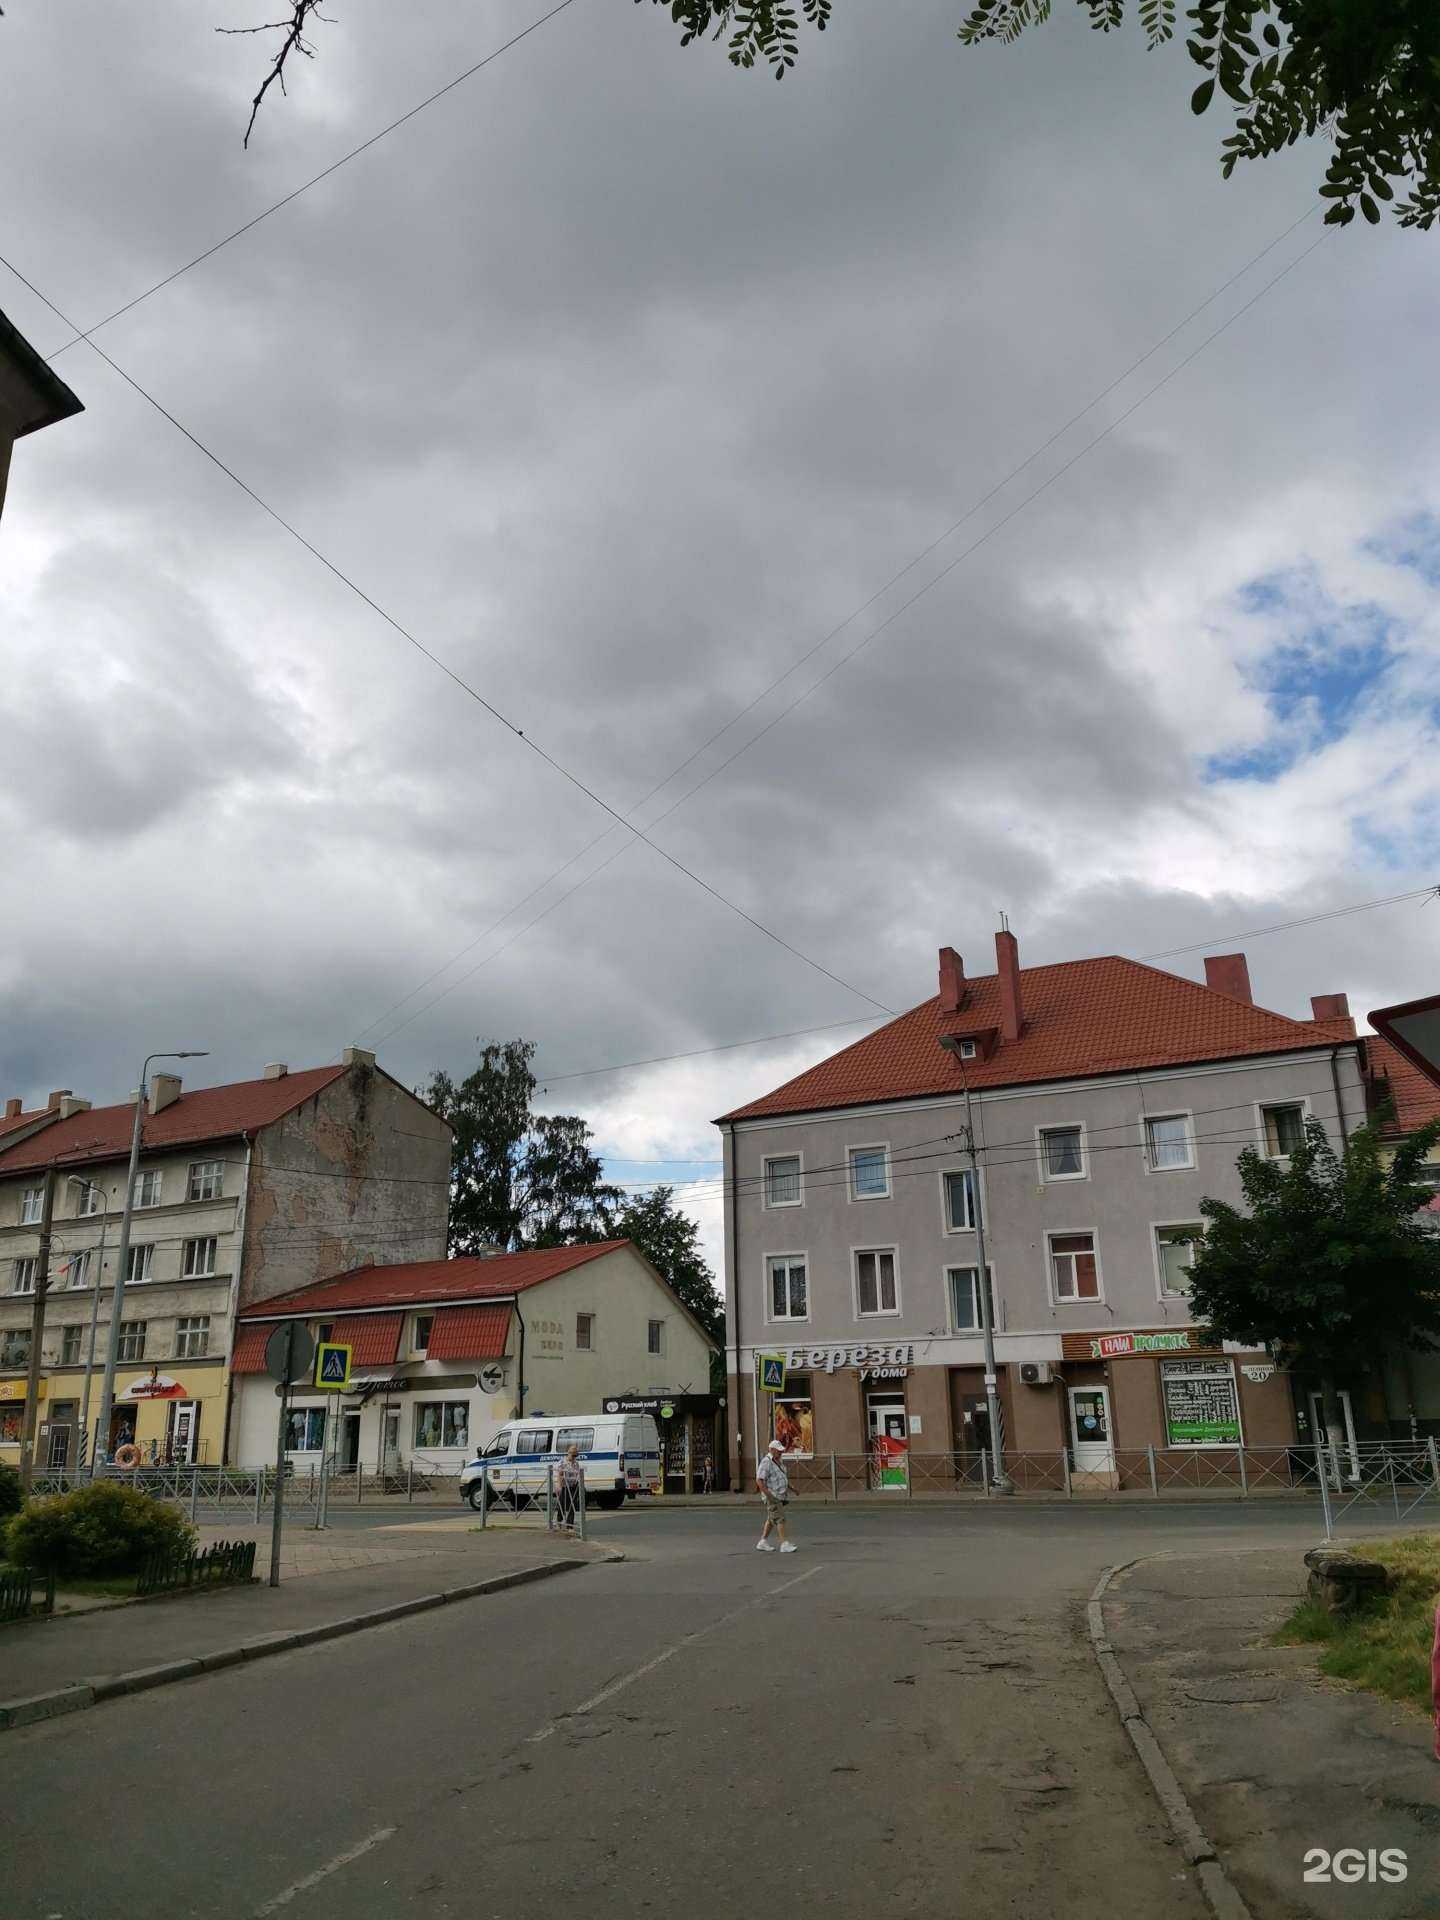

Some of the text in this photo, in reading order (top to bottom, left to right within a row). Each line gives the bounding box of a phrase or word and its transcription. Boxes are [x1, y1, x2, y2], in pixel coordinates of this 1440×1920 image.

[1103, 1335, 1131, 1353] НАШ
[871, 1366, 908, 1378] дома
[1251, 1371, 1267, 1380] 20
